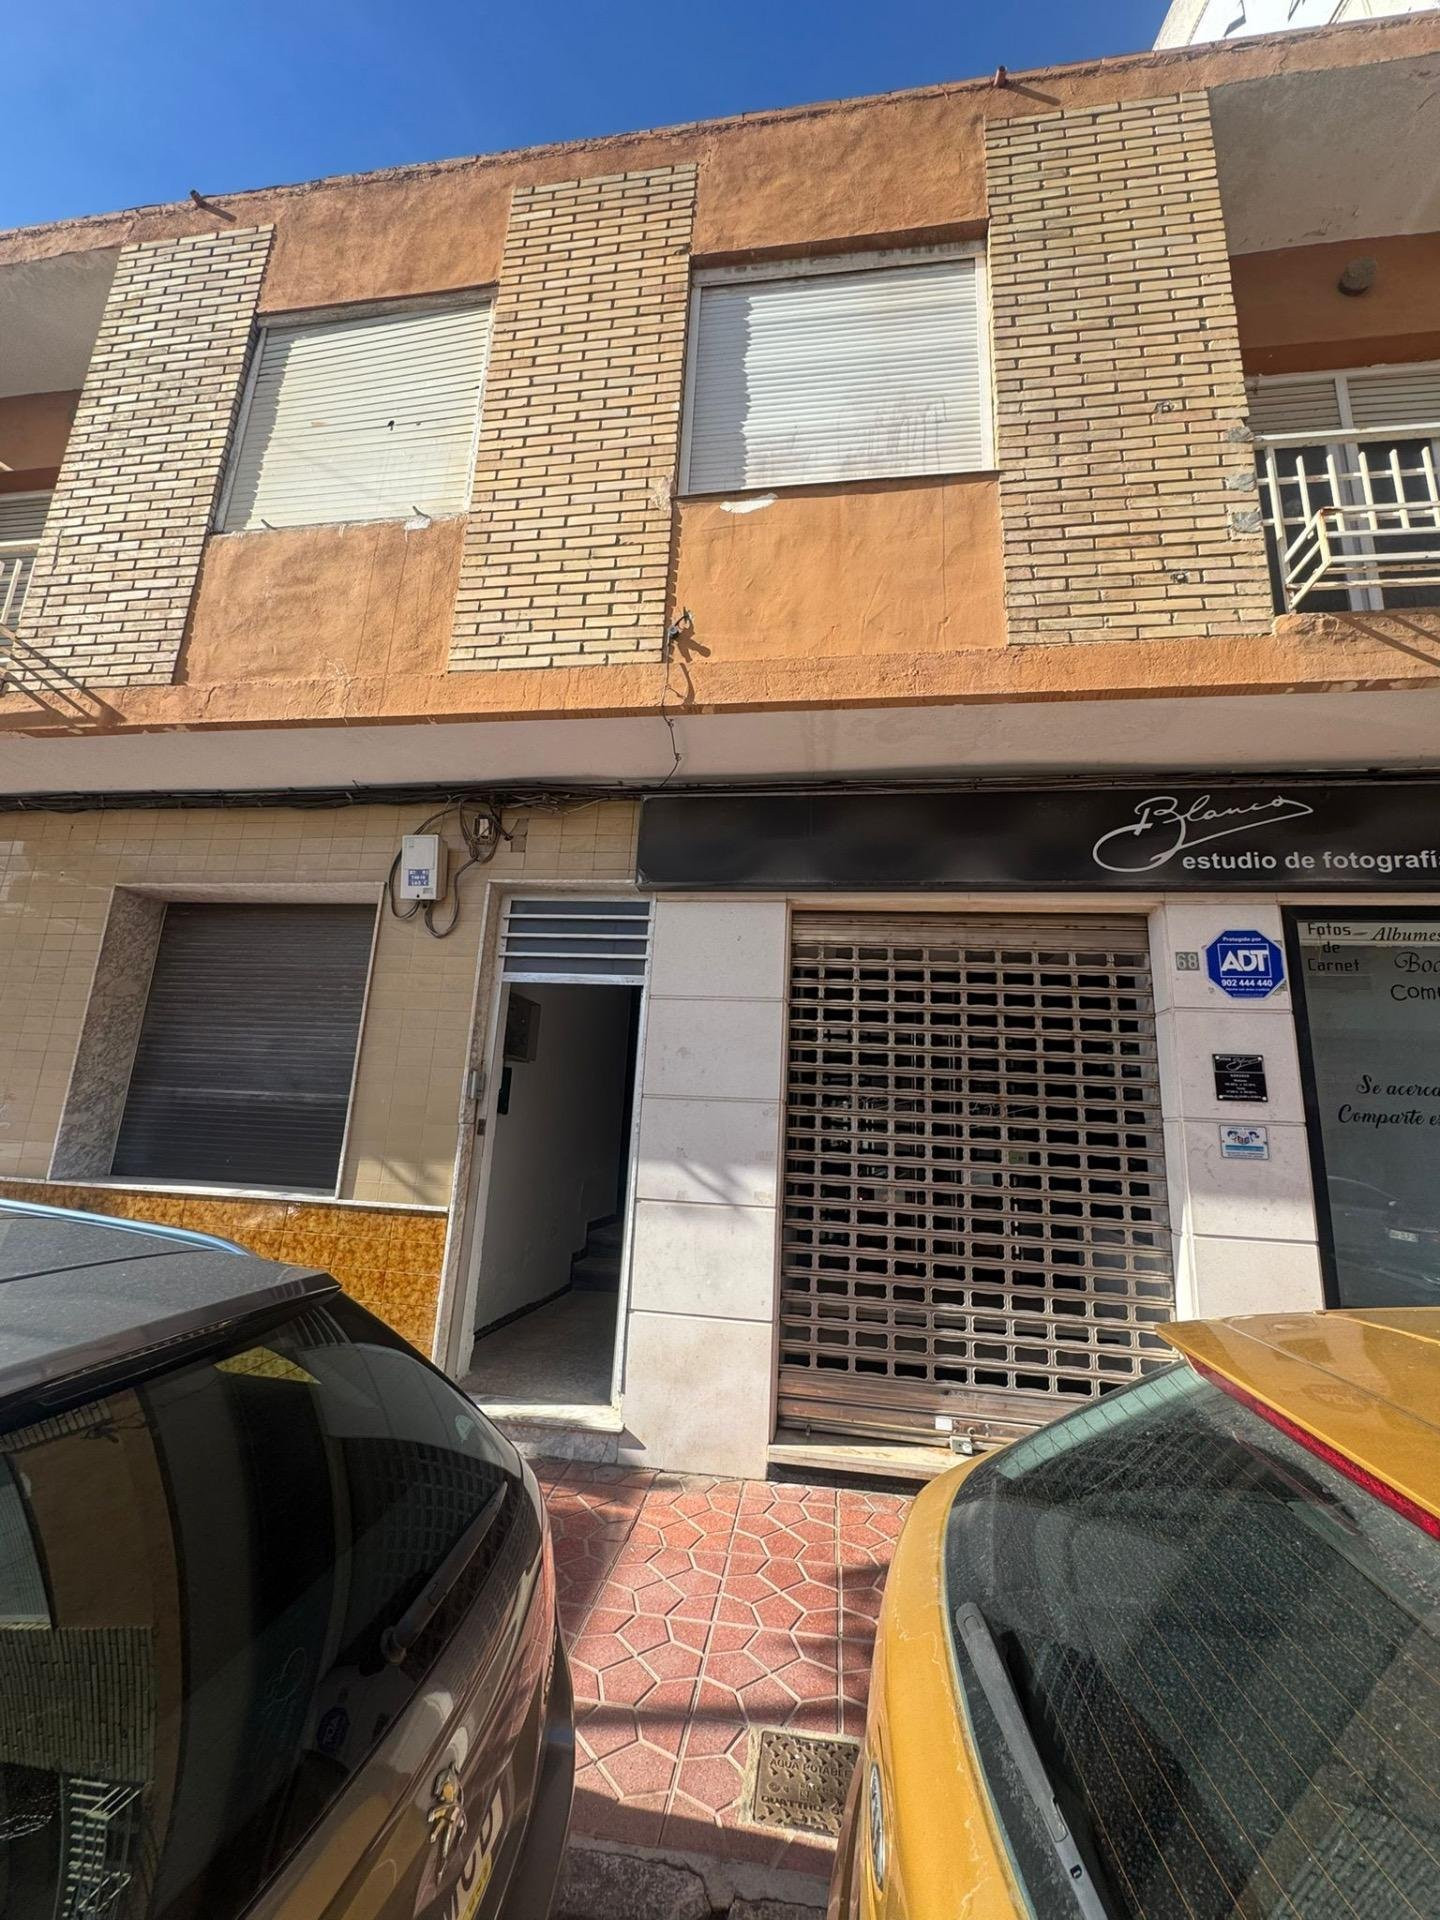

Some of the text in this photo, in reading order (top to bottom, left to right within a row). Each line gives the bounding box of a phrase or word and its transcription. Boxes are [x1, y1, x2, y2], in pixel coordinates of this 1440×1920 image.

[1092, 794, 1313, 873] Blanco
[1182, 851, 1277, 870] estudio
[1284, 850, 1316, 870] de
[1308, 922, 1352, 936] Fotos
[1371, 926, 1440, 942] Albumes
[1322, 941, 1341, 954] de
[1176, 953, 1198, 970] 68
[1220, 949, 1269, 972] ADT
[1308, 958, 1360, 972] Carnet
[1221, 978, 1273, 987] 902 444 440
[1390, 983, 1440, 1002] Com
[1355, 1074, 1440, 1097] Se acerca
[1337, 1103, 1423, 1129] Comparte
[803, 1764, 852, 1778] POTABLE
